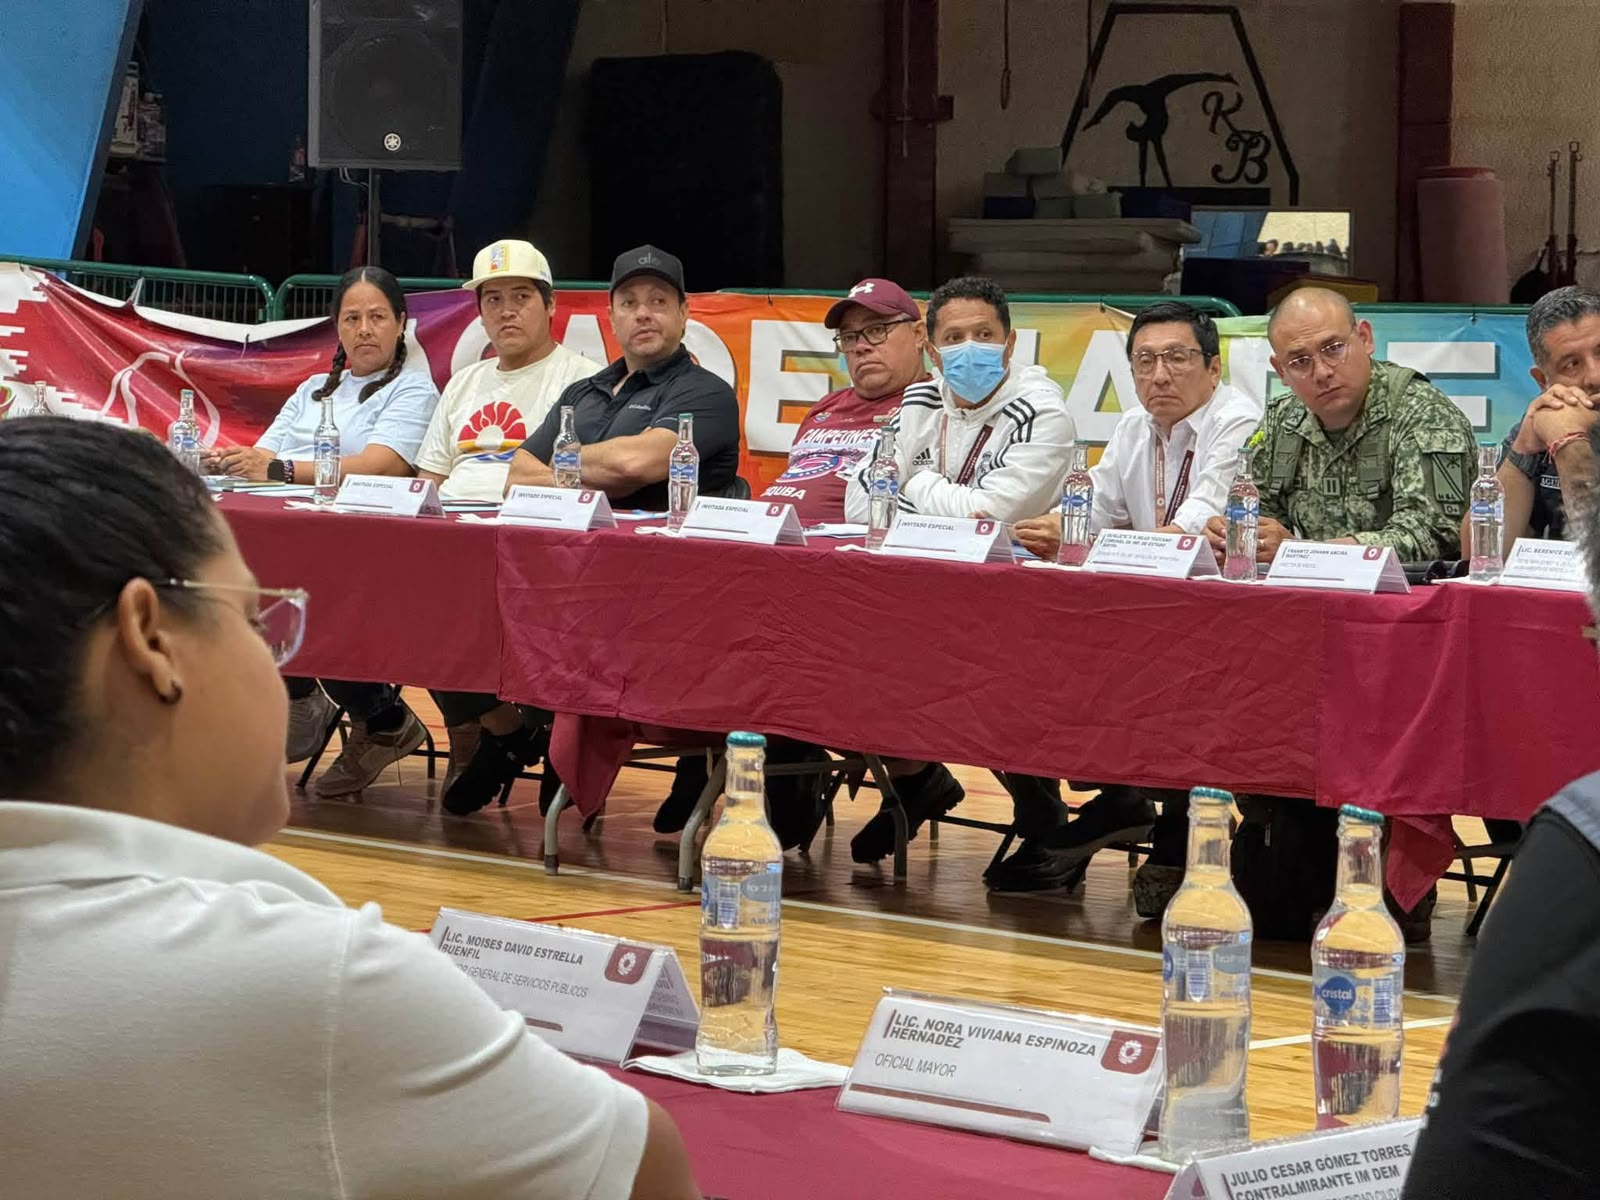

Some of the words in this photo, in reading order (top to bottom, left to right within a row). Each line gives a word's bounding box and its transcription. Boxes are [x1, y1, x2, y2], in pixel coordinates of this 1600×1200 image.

[901, 520, 927, 529] INVITADO
[928, 523, 954, 531] ESPECIAL
[441, 943, 481, 960] BUENFIL
[445, 930, 464, 944] LIC.
[466, 935, 503, 951] MOISES
[504, 941, 533, 956] DAVID
[534, 947, 584, 965] ESTRELLA
[467, 966, 500, 982] GENERAL
[500, 971, 513, 984] DE
[512, 974, 551, 991] SERVICIOS
[1321, 987, 1353, 1001] cristal
[889, 1026, 965, 1049] HERNADEZ
[894, 1013, 919, 1029] LIC.
[923, 1018, 963, 1036] NORA
[967, 1025, 1022, 1046] VIVIANA
[1025, 1034, 1096, 1057] ESPINOZA
[874, 1052, 914, 1072] OFICIAL
[916, 1058, 957, 1078] MAYOR
[1231, 1169, 1268, 1187] JULIO
[1271, 1161, 1314, 1181] CESAR
[1361, 1143, 1412, 1164] TORRES
[1236, 1173, 1353, 1200] CONTRALMIRANTE
[1355, 1171, 1371, 1184] IM
[1372, 1164, 1400, 1181] DEM
